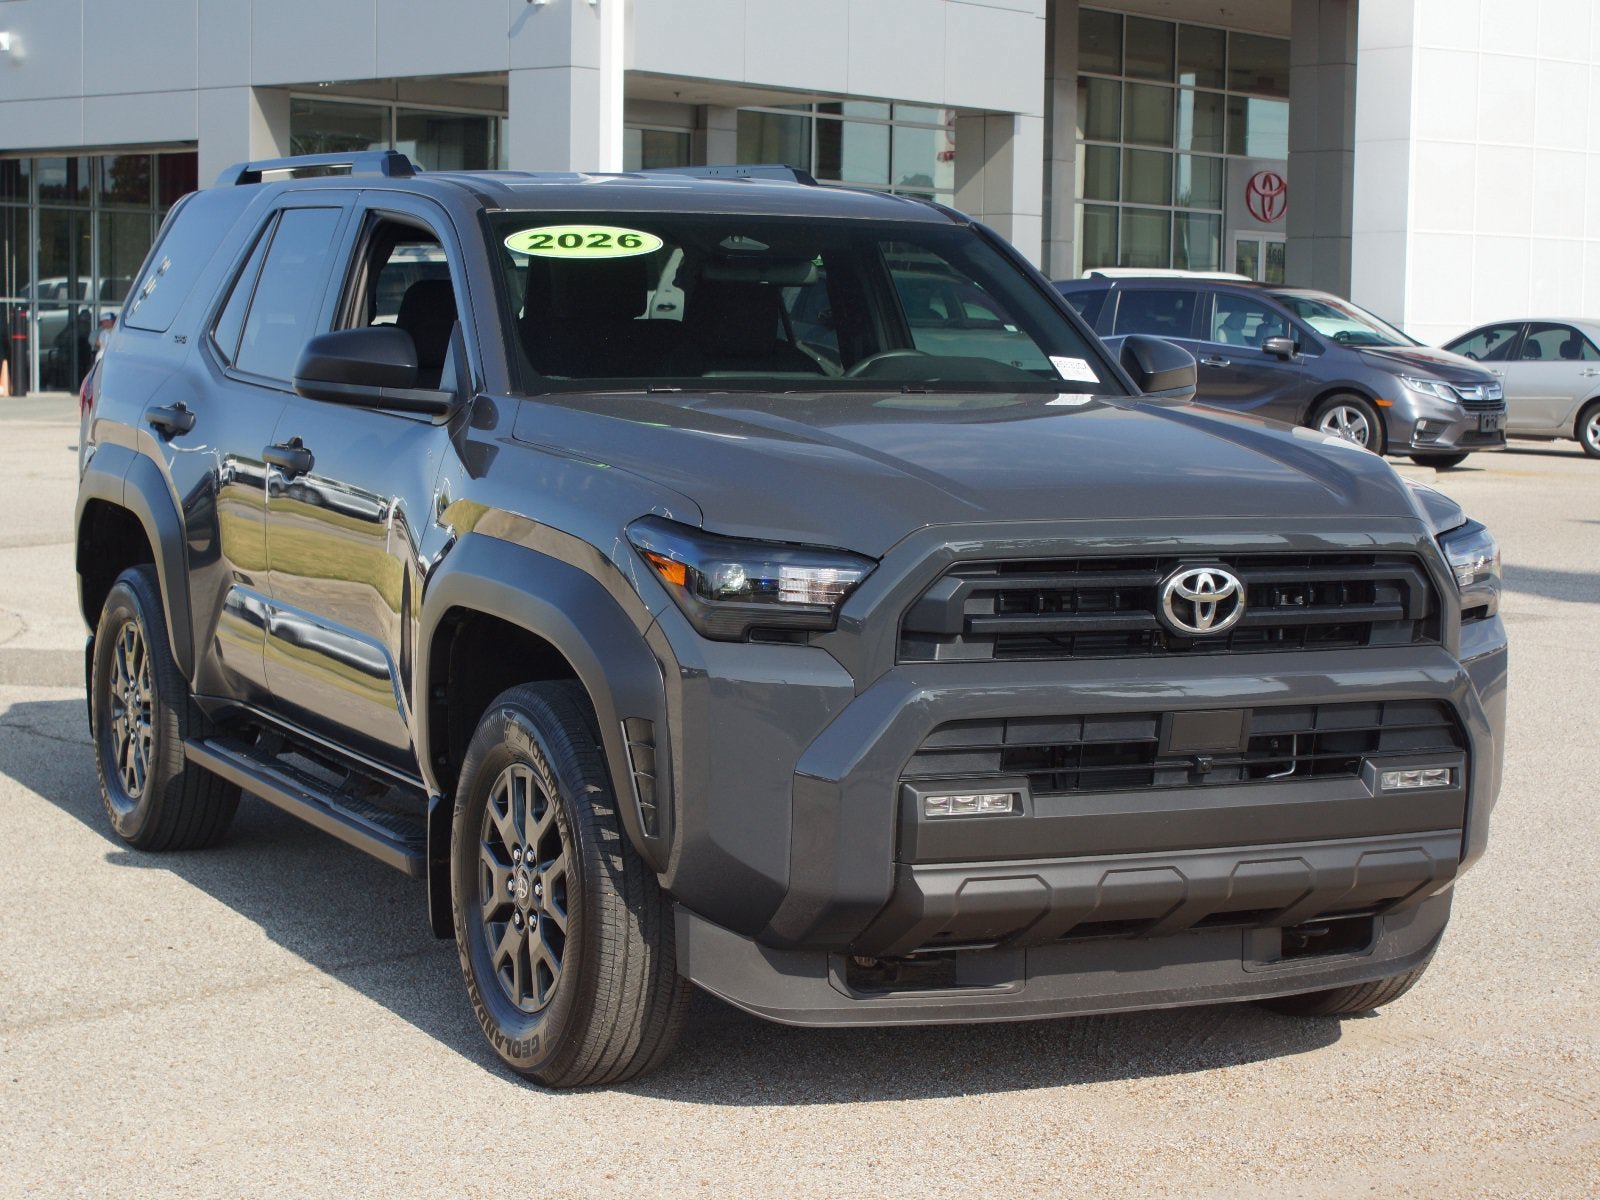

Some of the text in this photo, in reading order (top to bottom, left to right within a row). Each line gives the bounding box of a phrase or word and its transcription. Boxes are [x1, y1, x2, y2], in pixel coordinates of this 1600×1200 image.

[527, 233, 642, 249] 2026
[527, 731, 571, 844] YOKOHAMA
[463, 967, 540, 1058] GEOLANDAR
